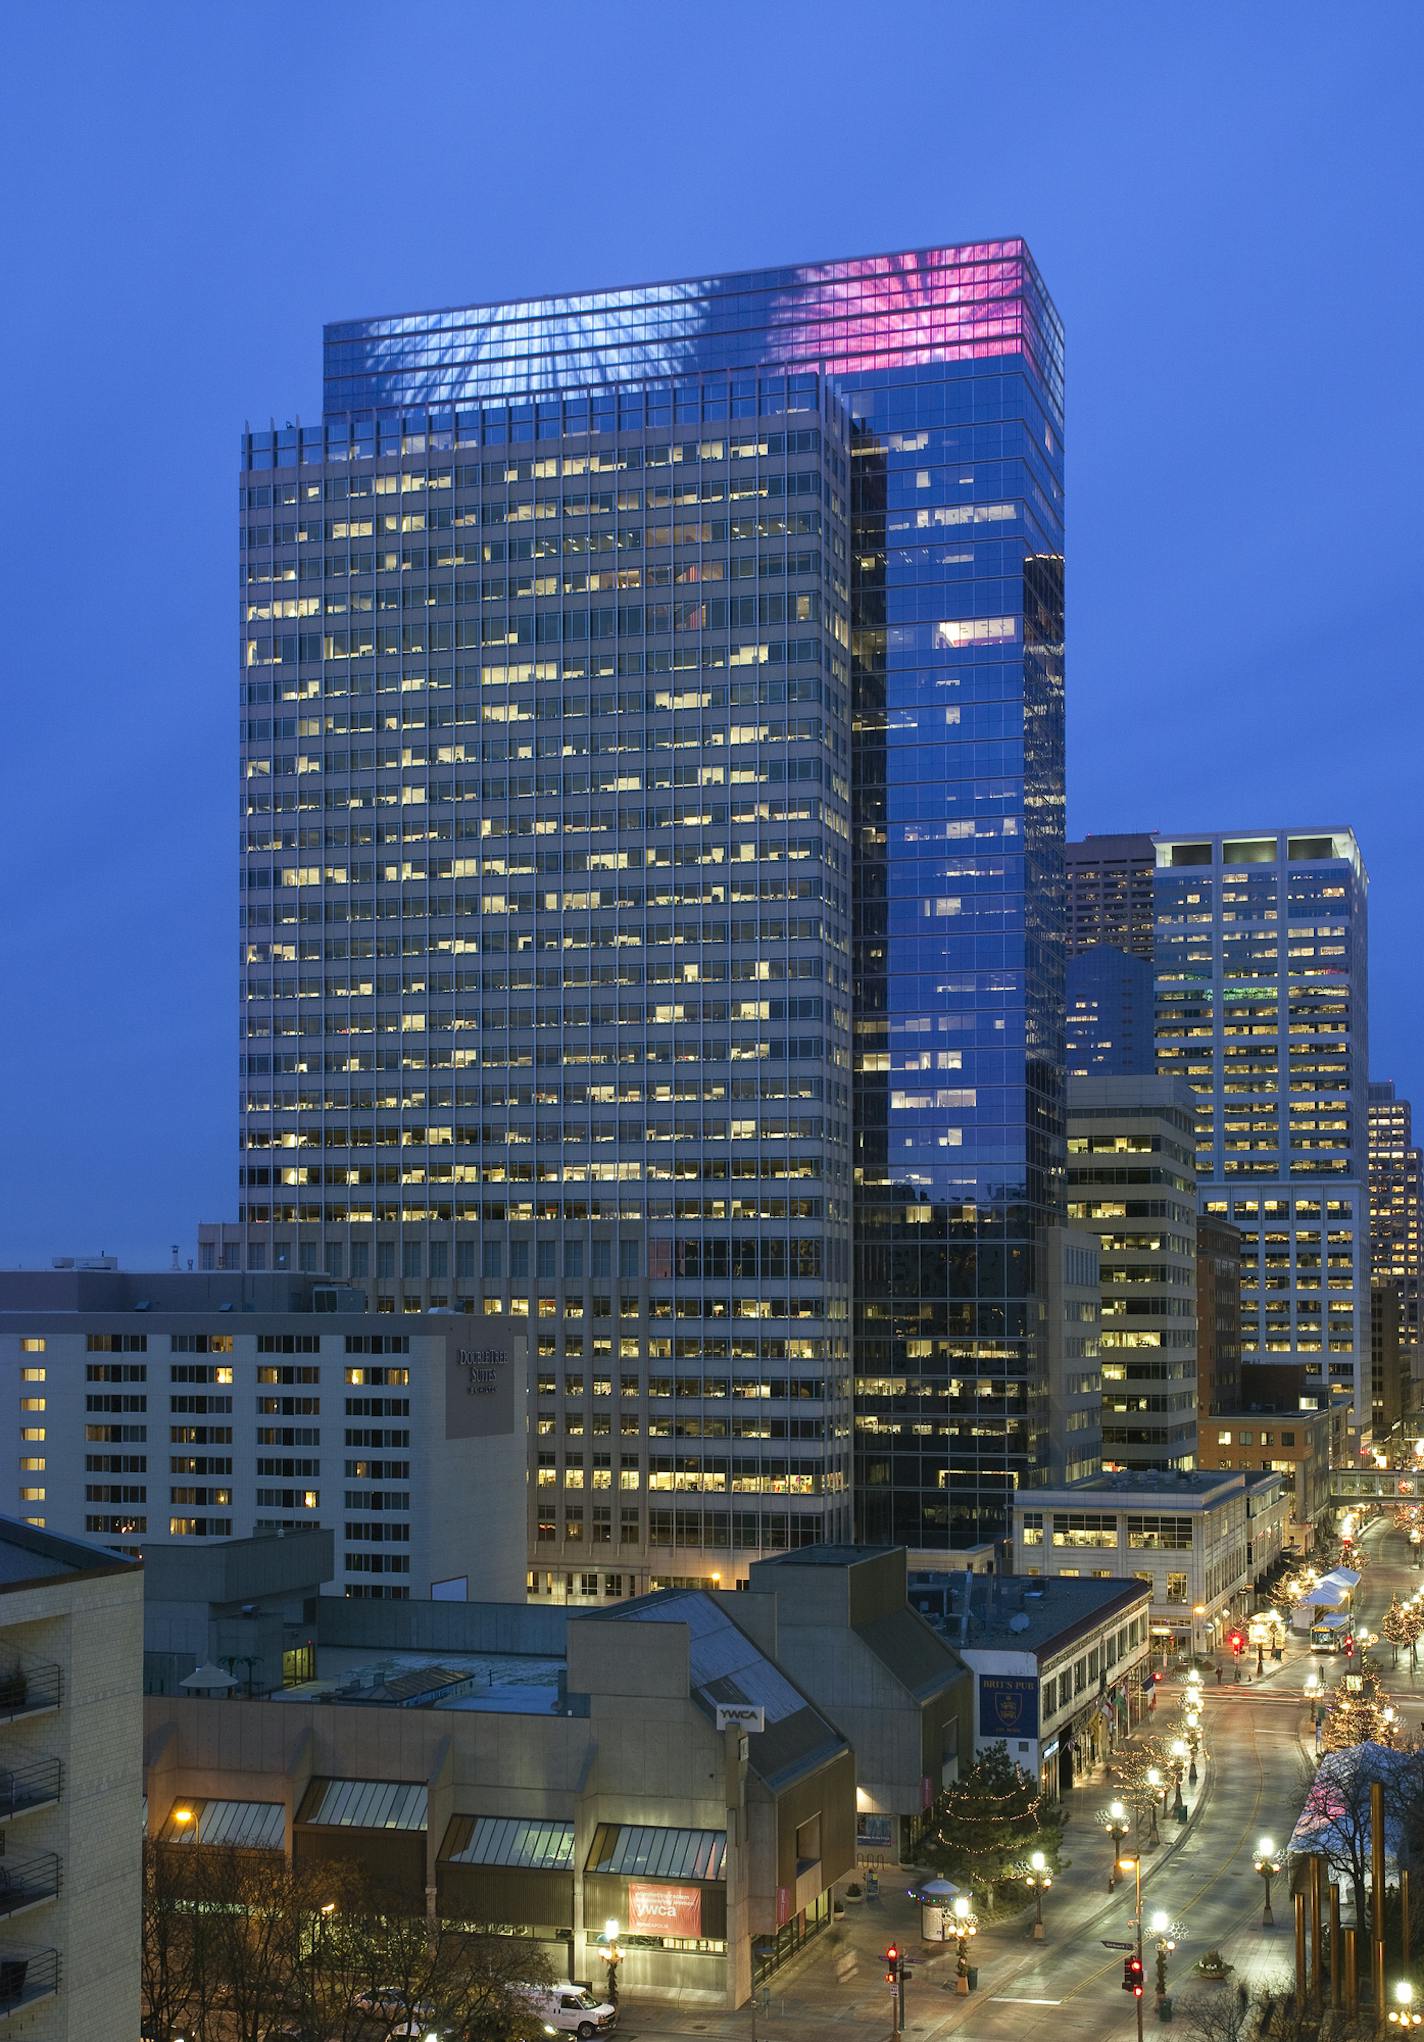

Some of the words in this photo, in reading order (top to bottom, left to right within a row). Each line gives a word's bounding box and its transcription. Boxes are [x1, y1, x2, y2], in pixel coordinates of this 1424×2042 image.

[471, 1366, 497, 1382] SUITES
[1015, 1681, 1035, 1690] PUB
[720, 1709, 758, 1720] YWCA
[636, 1903, 677, 1917] ywca
